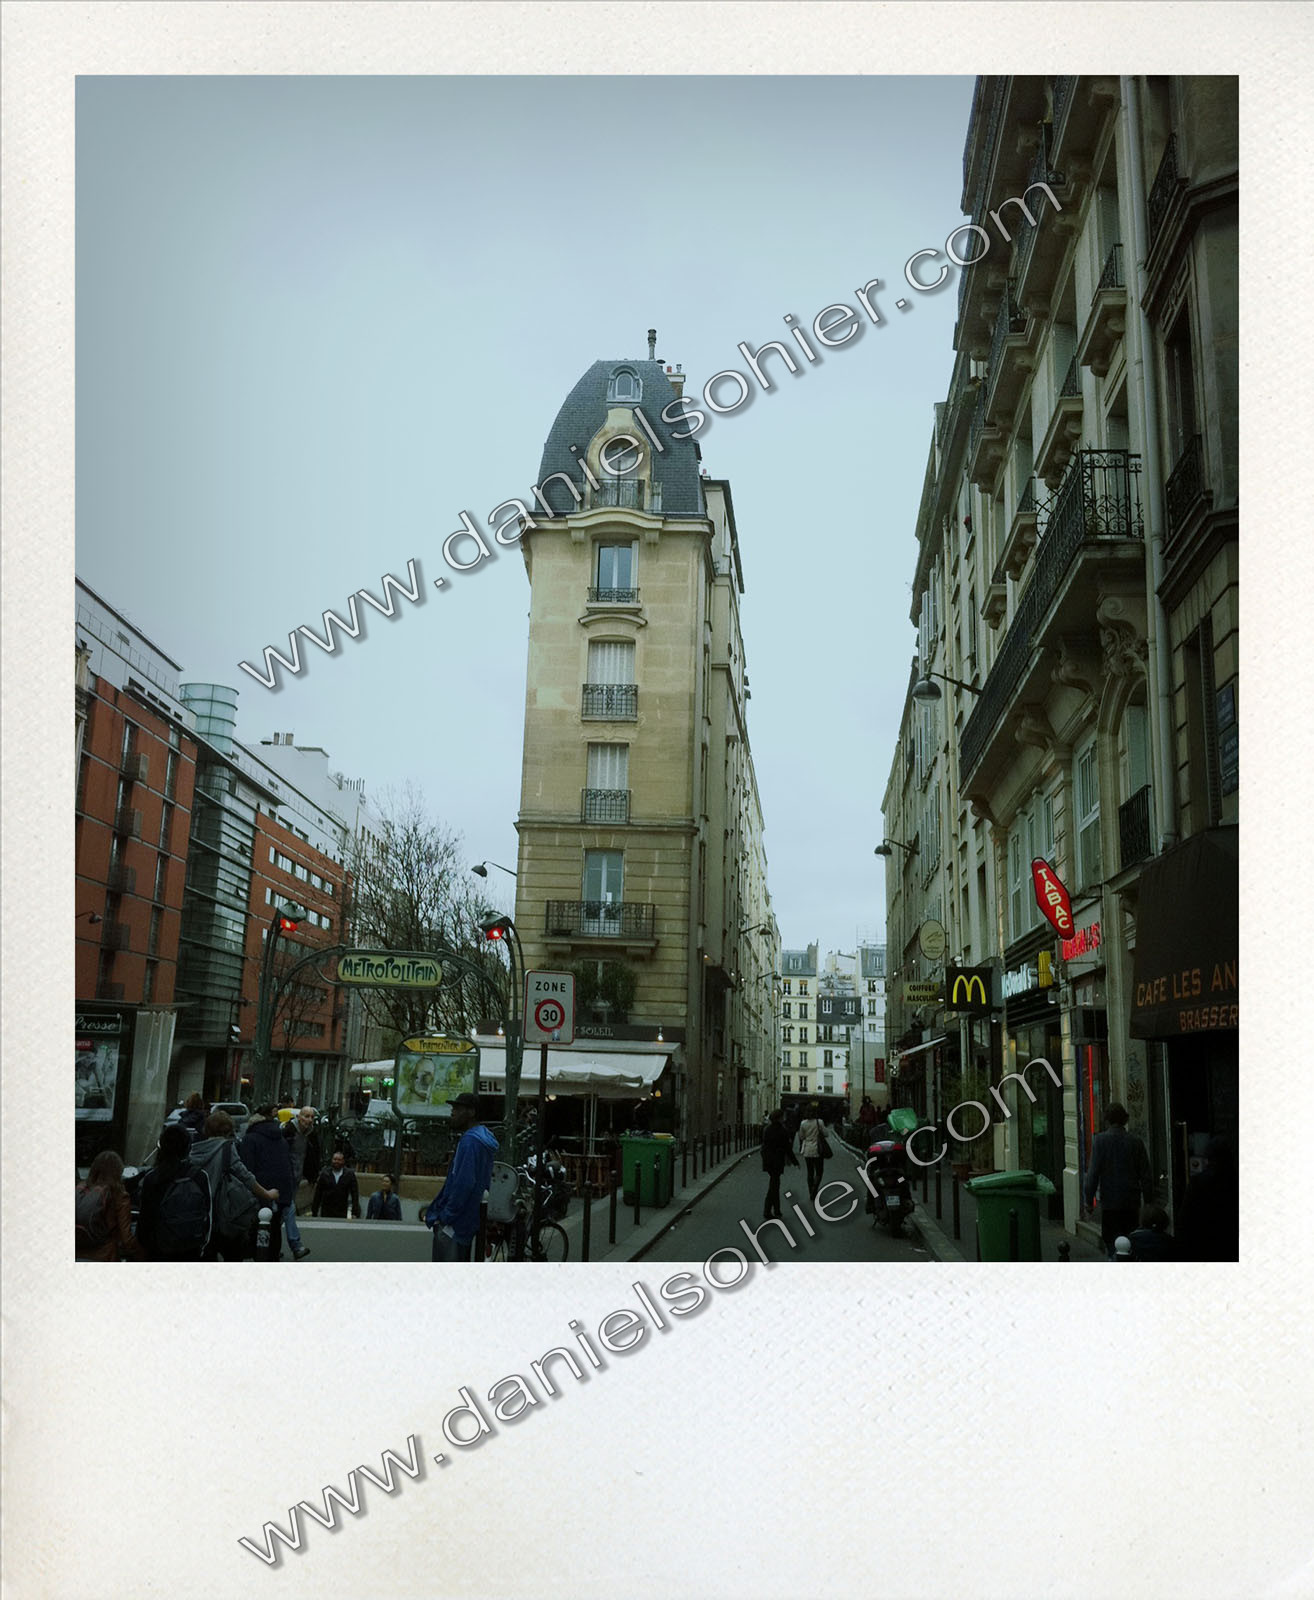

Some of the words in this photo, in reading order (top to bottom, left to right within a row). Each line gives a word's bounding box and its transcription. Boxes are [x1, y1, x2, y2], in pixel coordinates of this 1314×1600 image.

[1038, 868, 1070, 929] TABAC
[342, 957, 438, 983] METROPOLITAIN
[535, 981, 566, 993] ZONE
[909, 984, 935, 992] COIFFURE
[1136, 976, 1168, 1008] CAFE
[1172, 968, 1201, 1000] LES
[1211, 960, 1237, 992] AN
[542, 1009, 558, 1022] 30
[580, 1026, 614, 1037] SOLEIL
